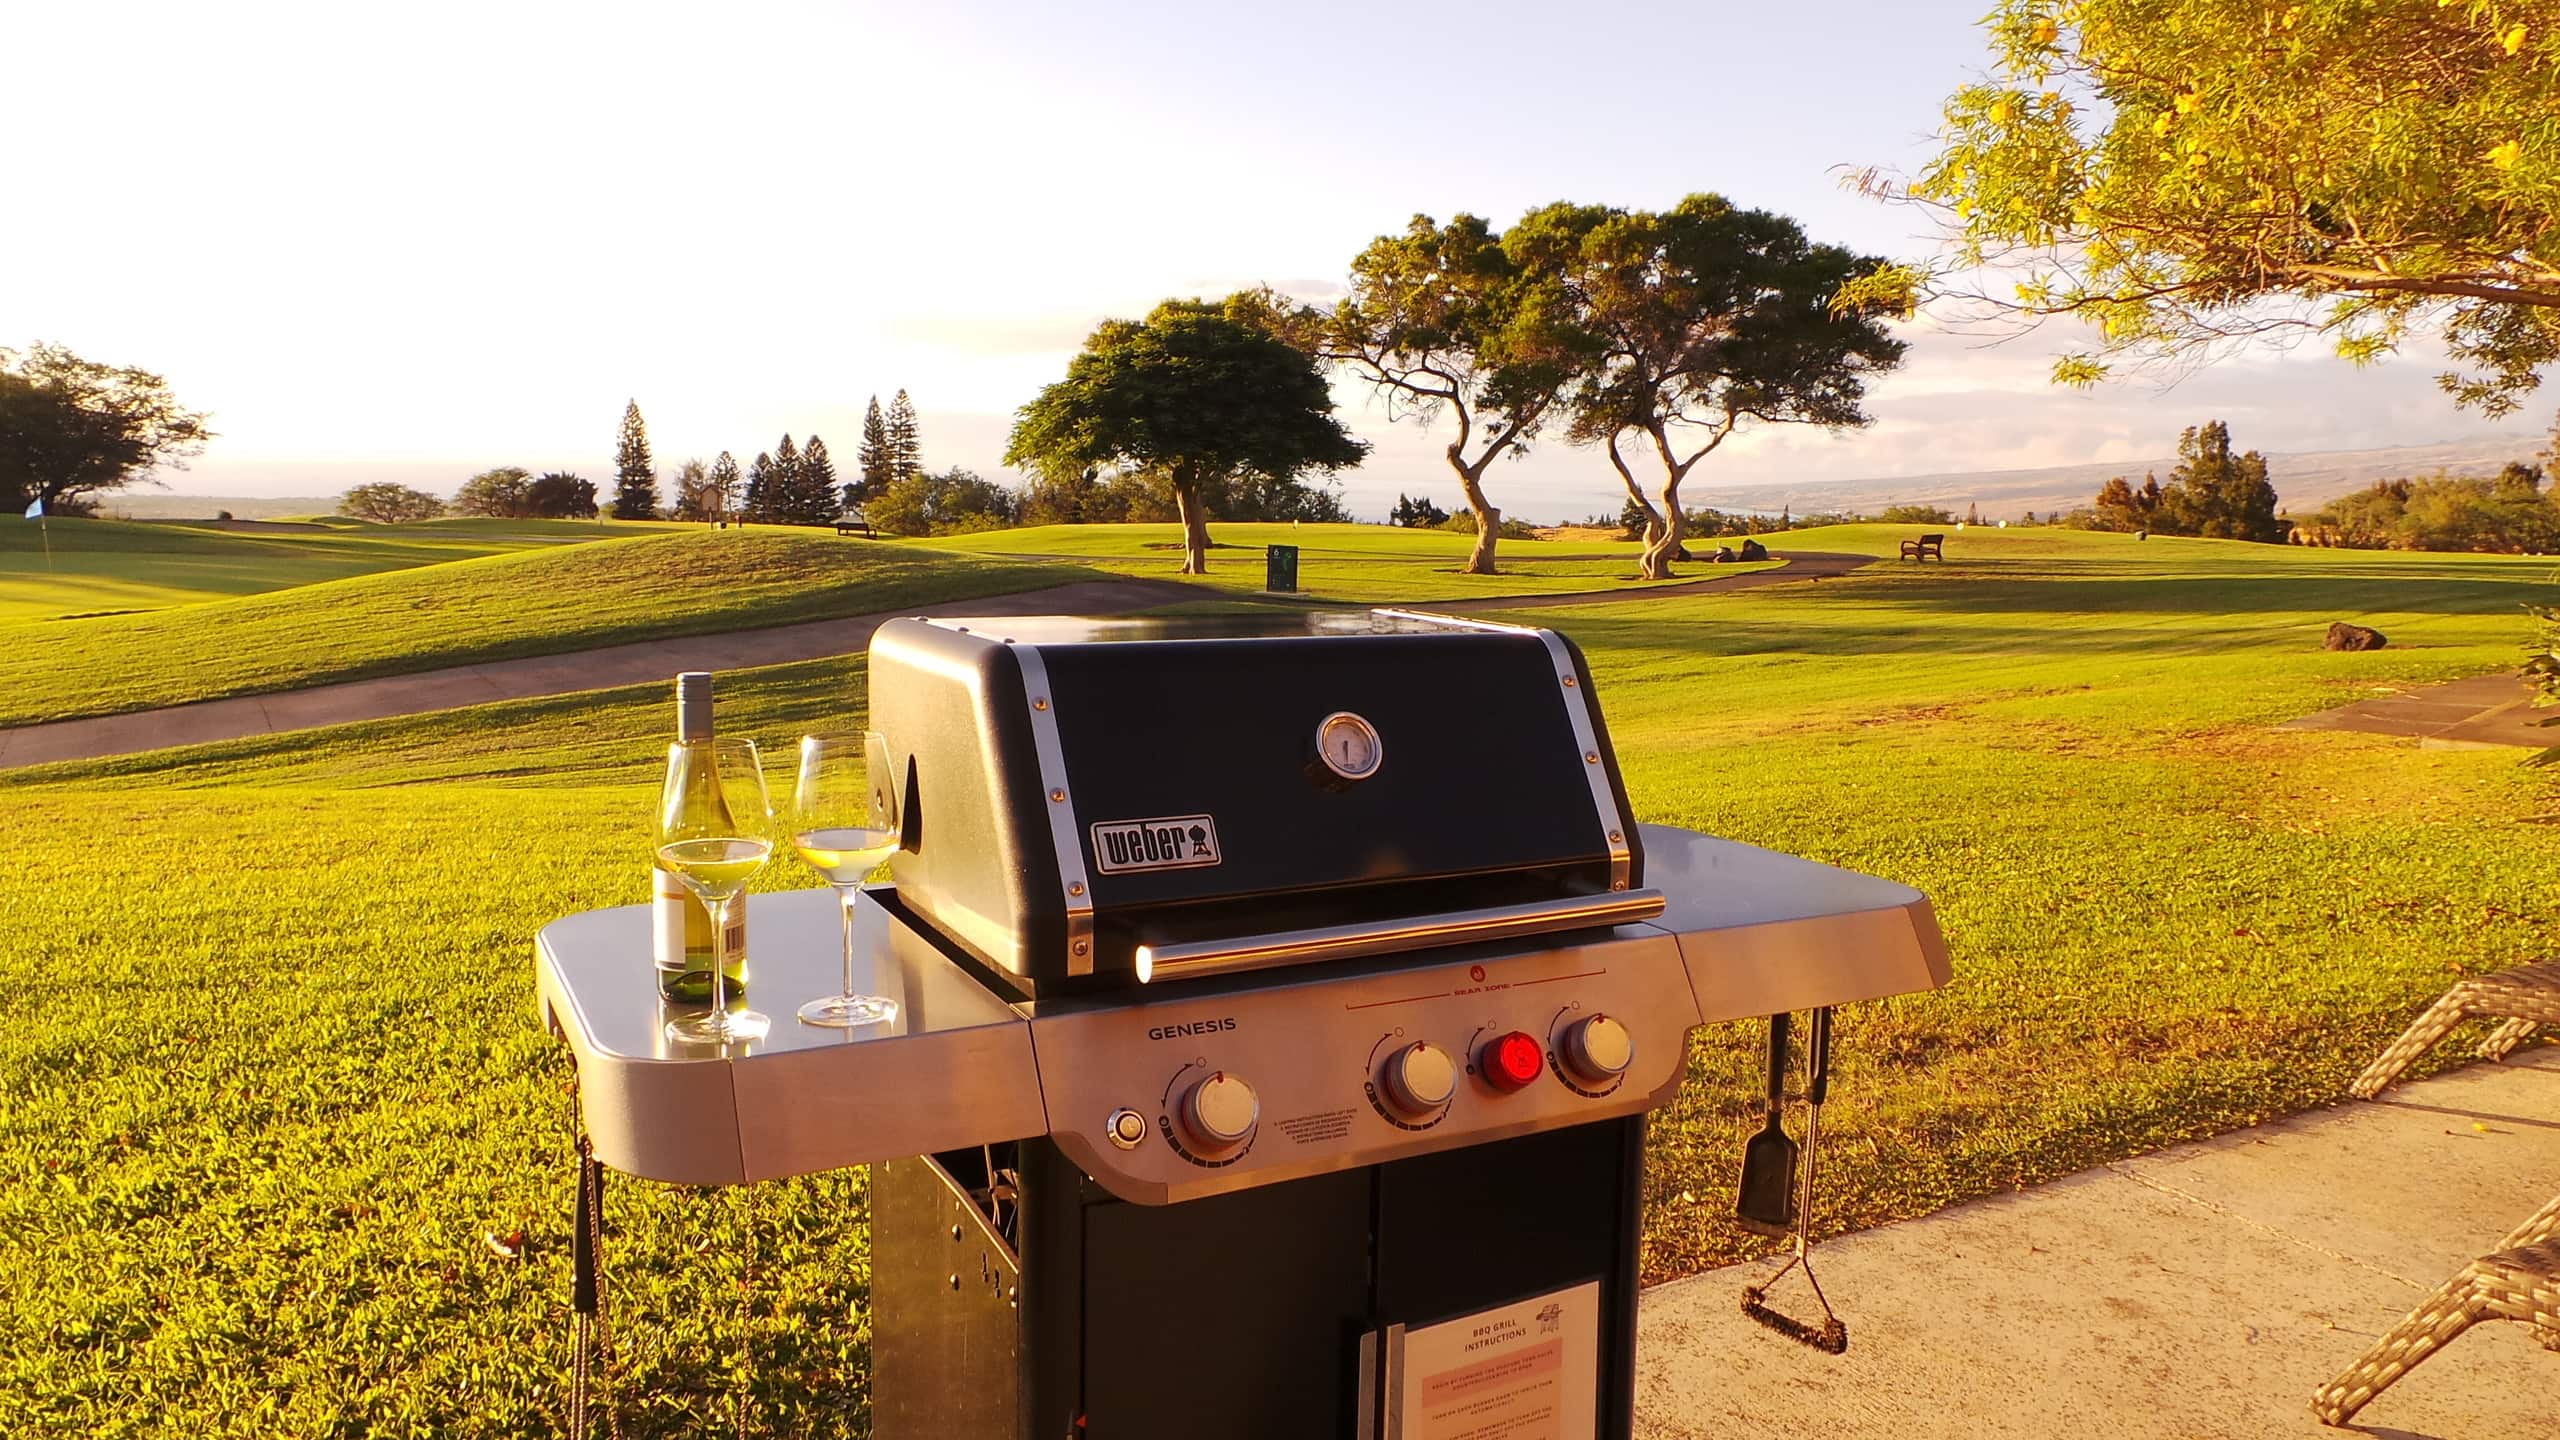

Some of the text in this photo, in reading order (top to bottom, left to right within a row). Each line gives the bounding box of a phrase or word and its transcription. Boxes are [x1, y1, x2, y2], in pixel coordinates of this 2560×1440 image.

[1104, 823, 1186, 865] weber
[1148, 1018, 1237, 1041] GENESIS
[1464, 1327, 1528, 1353] INSTRUCTIONS
[1473, 1319, 1517, 1338] BBQ GRILL
